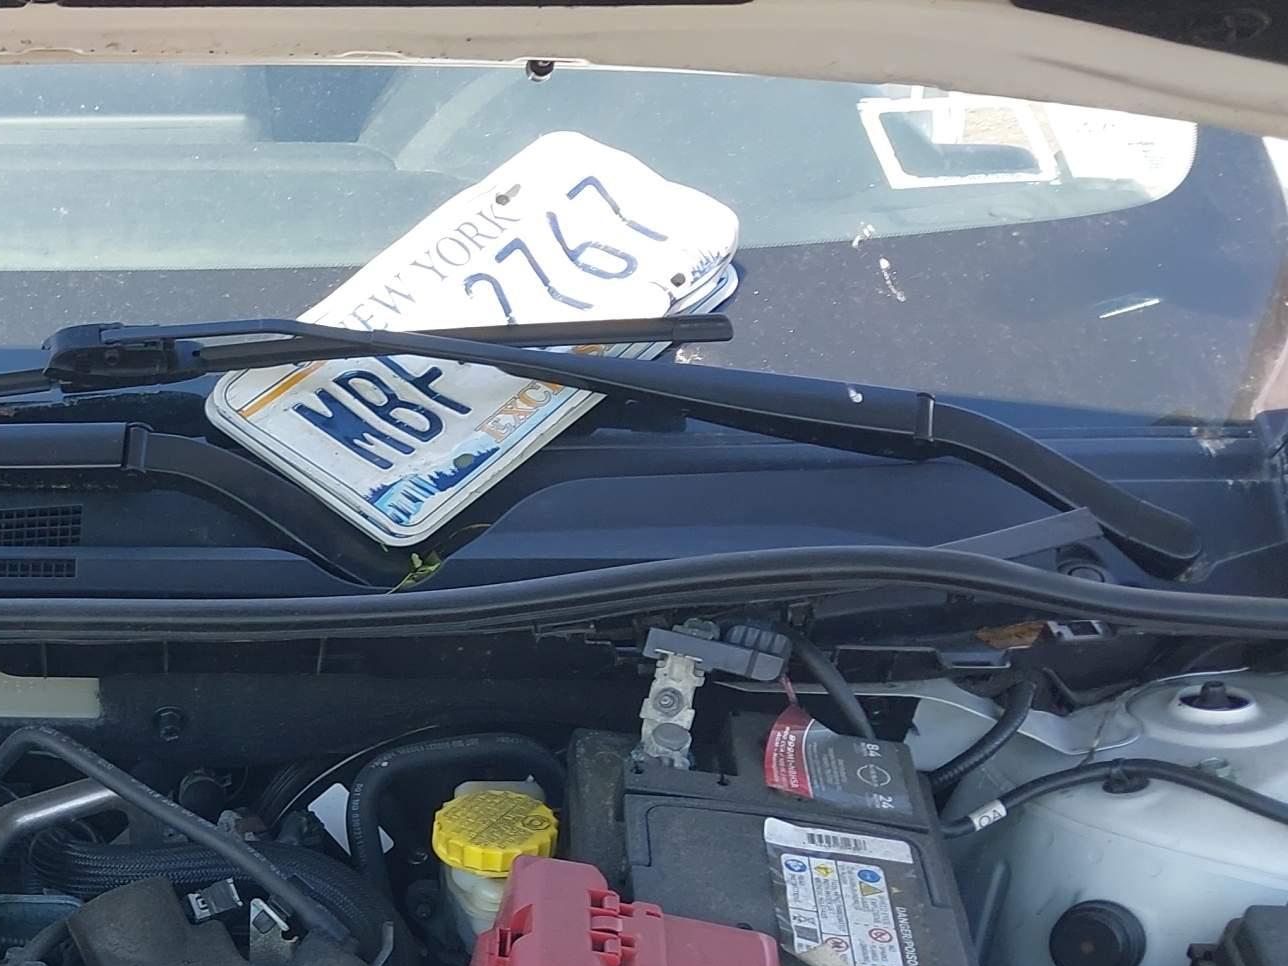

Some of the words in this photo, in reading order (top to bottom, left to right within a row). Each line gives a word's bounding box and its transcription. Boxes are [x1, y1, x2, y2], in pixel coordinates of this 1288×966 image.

[410, 203, 521, 280] YORK
[291, 356, 472, 470] MBF
[464, 175, 669, 326] 2767
[866, 743, 882, 758] 84
[879, 794, 895, 809] 24
